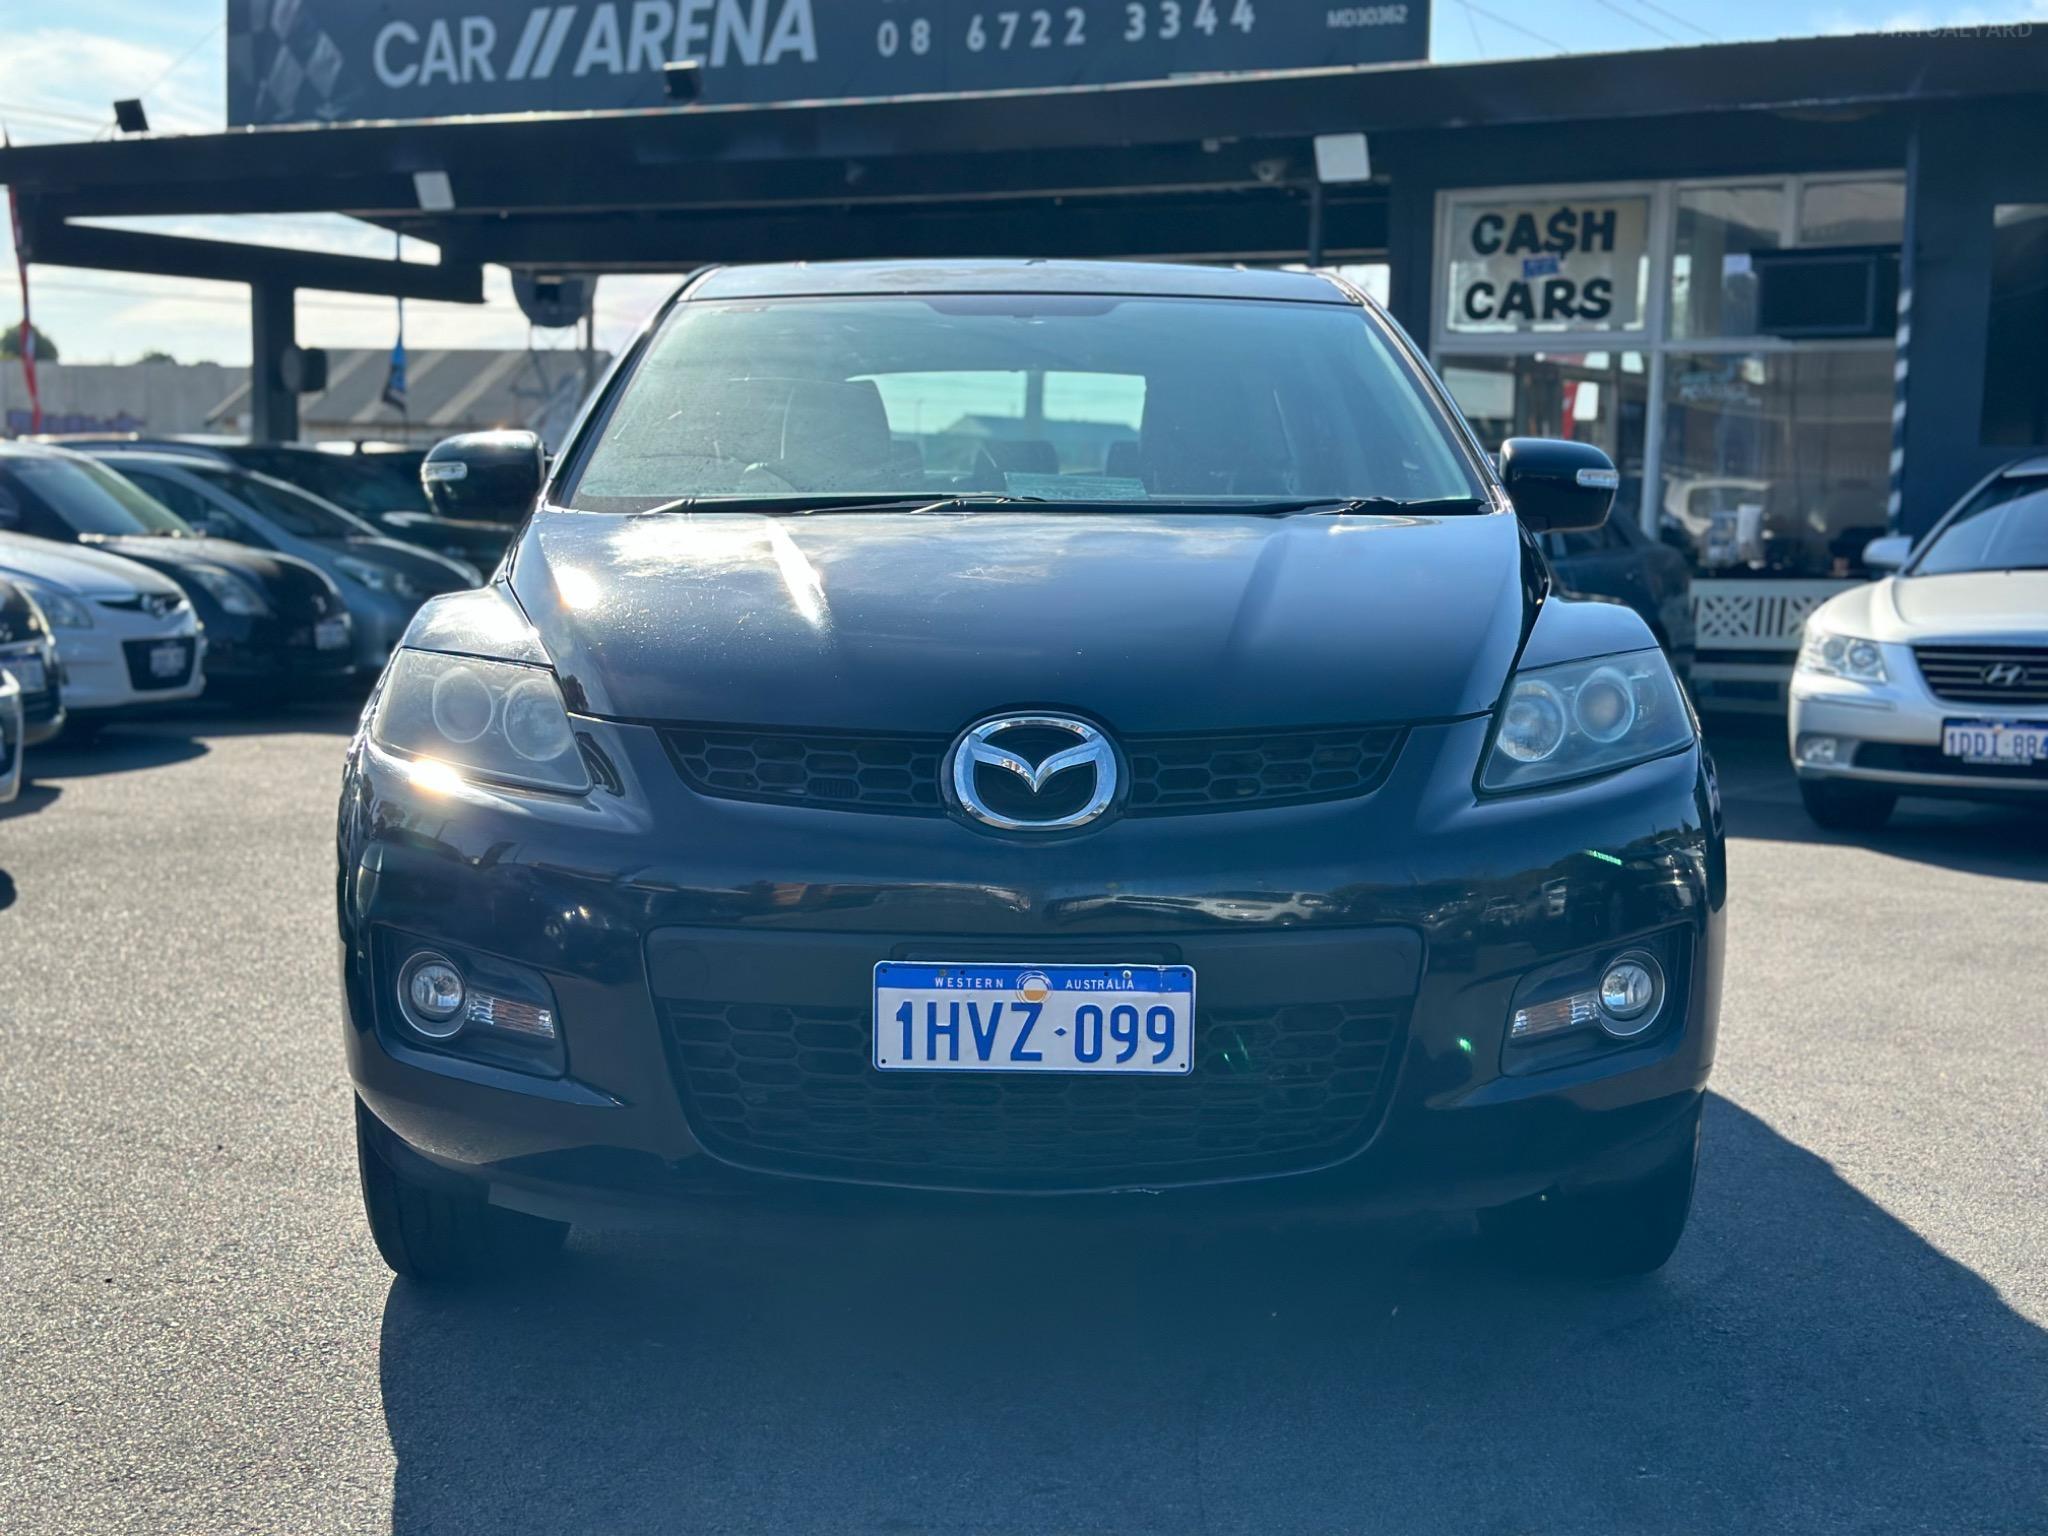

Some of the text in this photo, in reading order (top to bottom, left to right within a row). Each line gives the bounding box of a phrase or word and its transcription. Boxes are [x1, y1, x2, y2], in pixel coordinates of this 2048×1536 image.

[373, 0, 818, 88] CAR ARENA
[877, 0, 1255, 57] 08 6722 3344
[1464, 277, 1613, 321] CARS
[934, 977, 1135, 990] WESTERN AUSTRALIA
